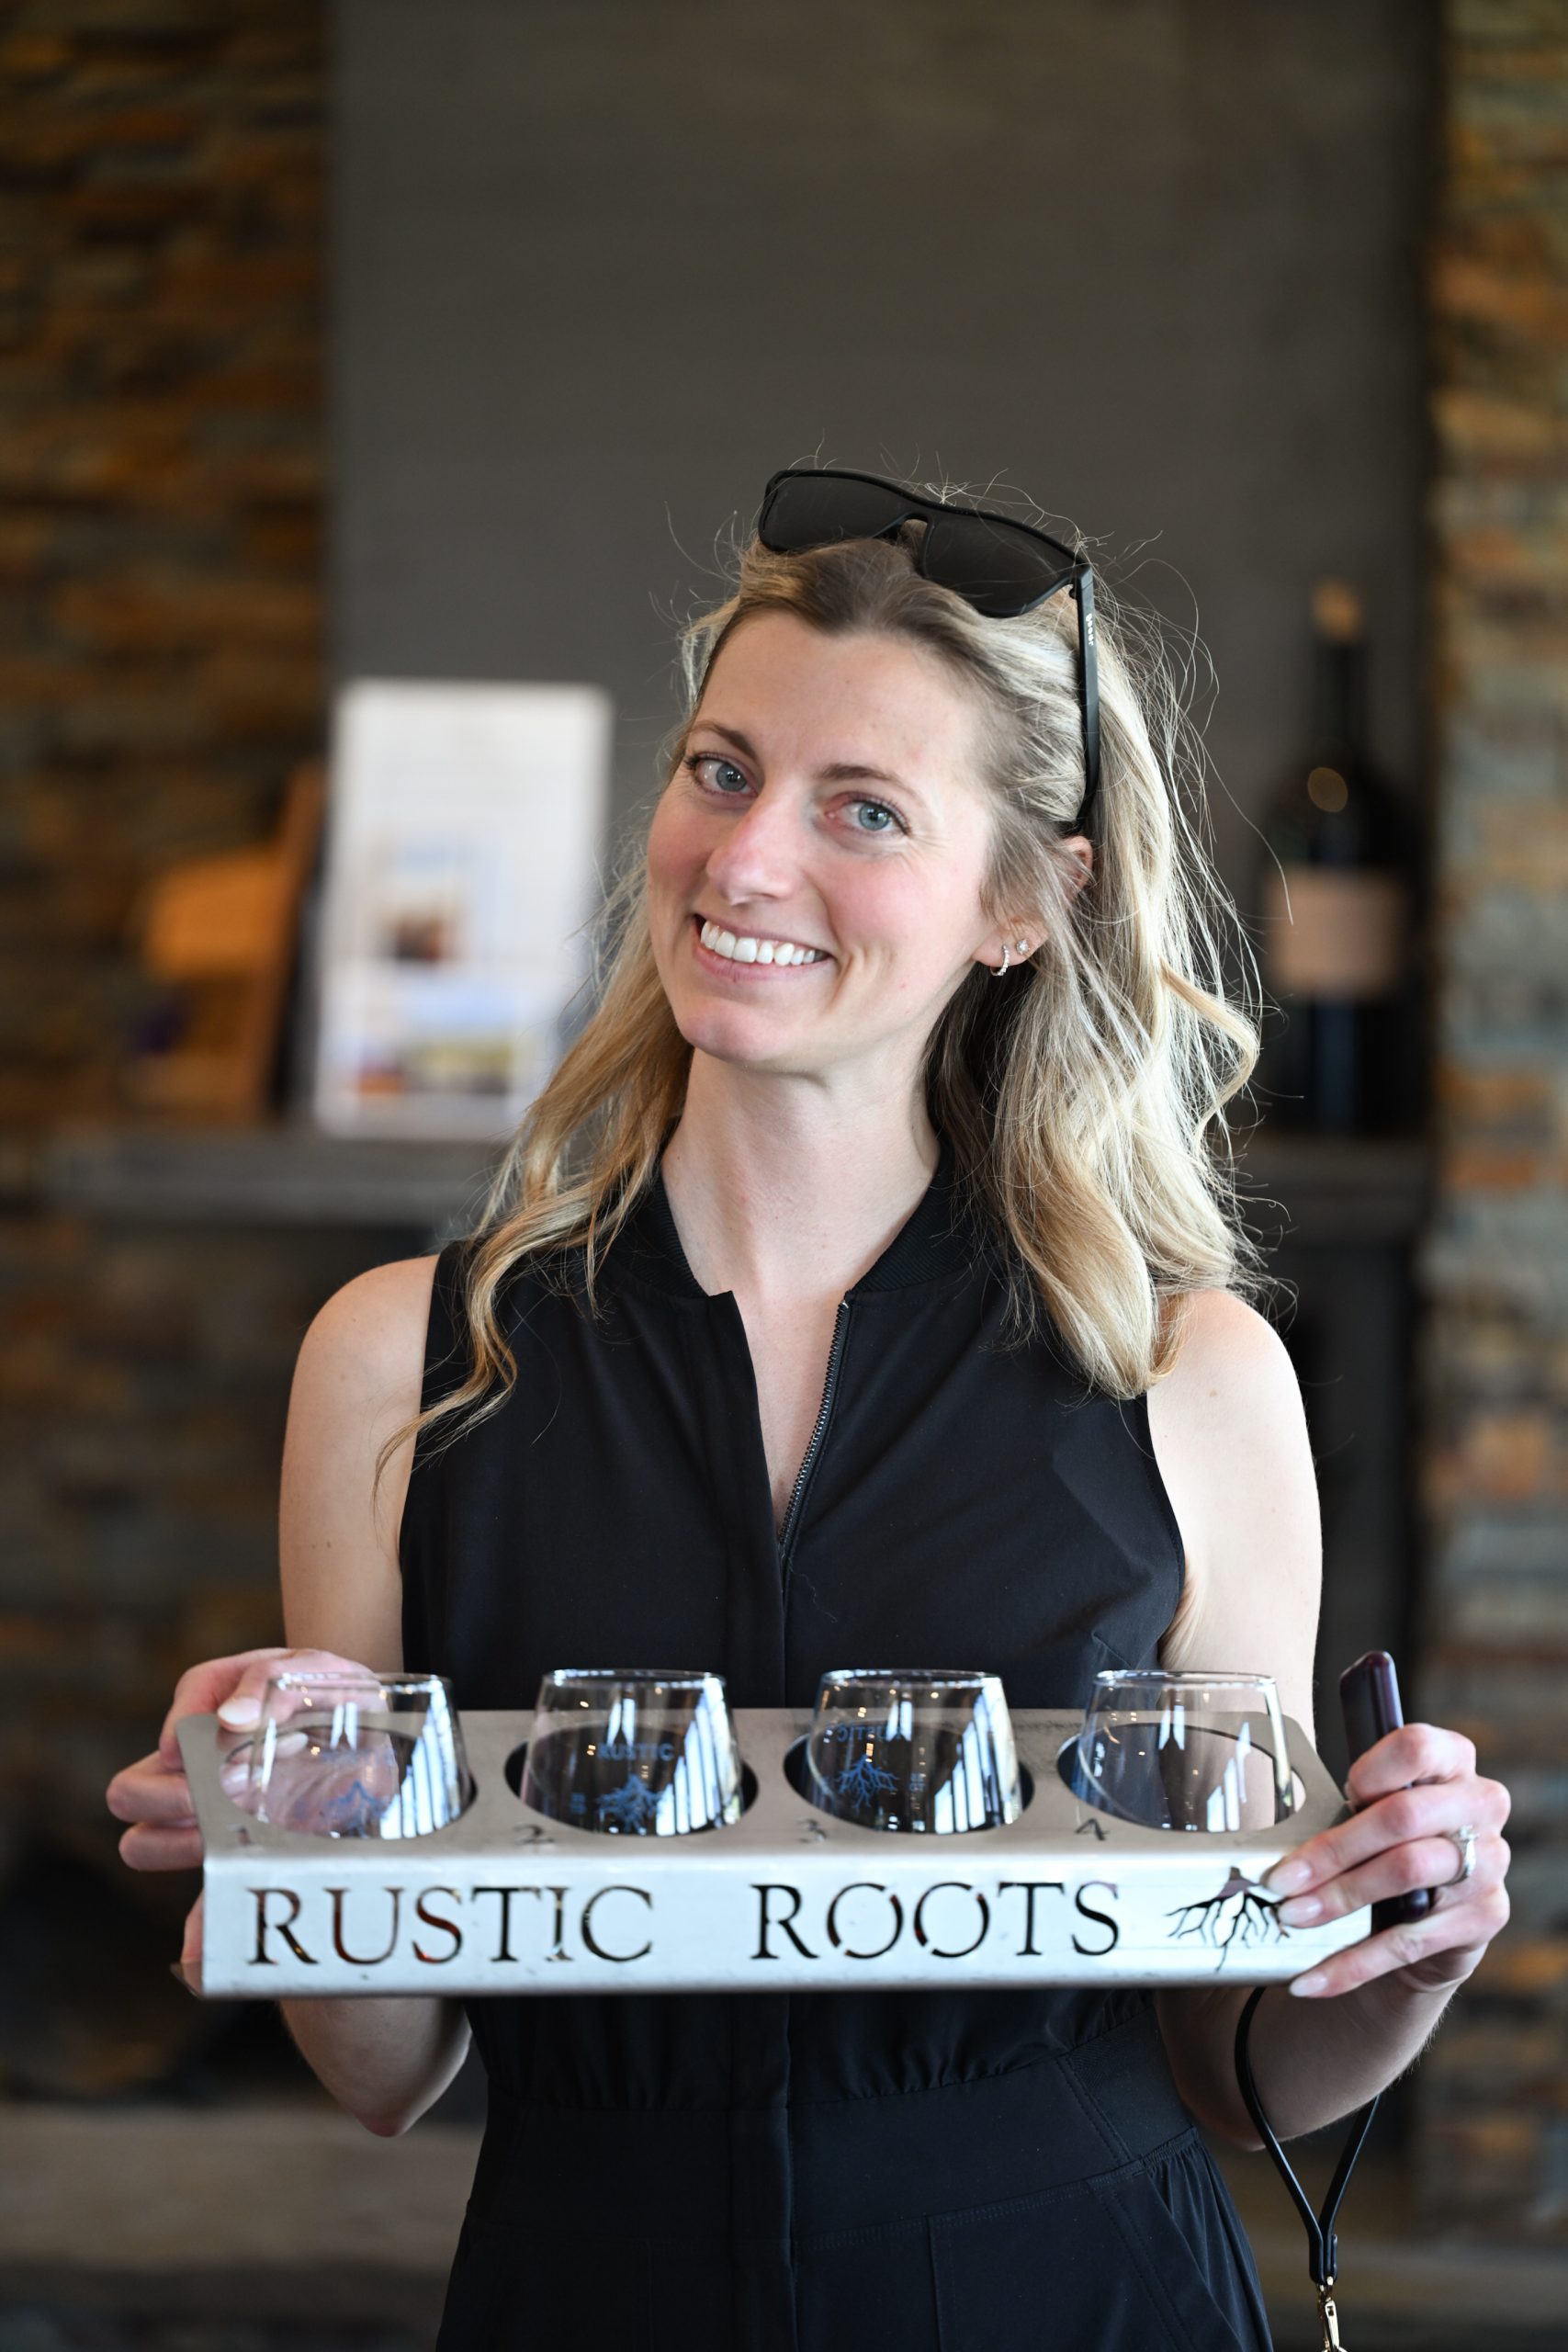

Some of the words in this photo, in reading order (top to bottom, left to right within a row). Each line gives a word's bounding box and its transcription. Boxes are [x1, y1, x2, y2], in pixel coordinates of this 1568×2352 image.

[597, 1743, 675, 1761] RUSTIC
[246, 1883, 655, 1965] RUSTIC
[749, 1881, 1121, 1959] ROOTS
